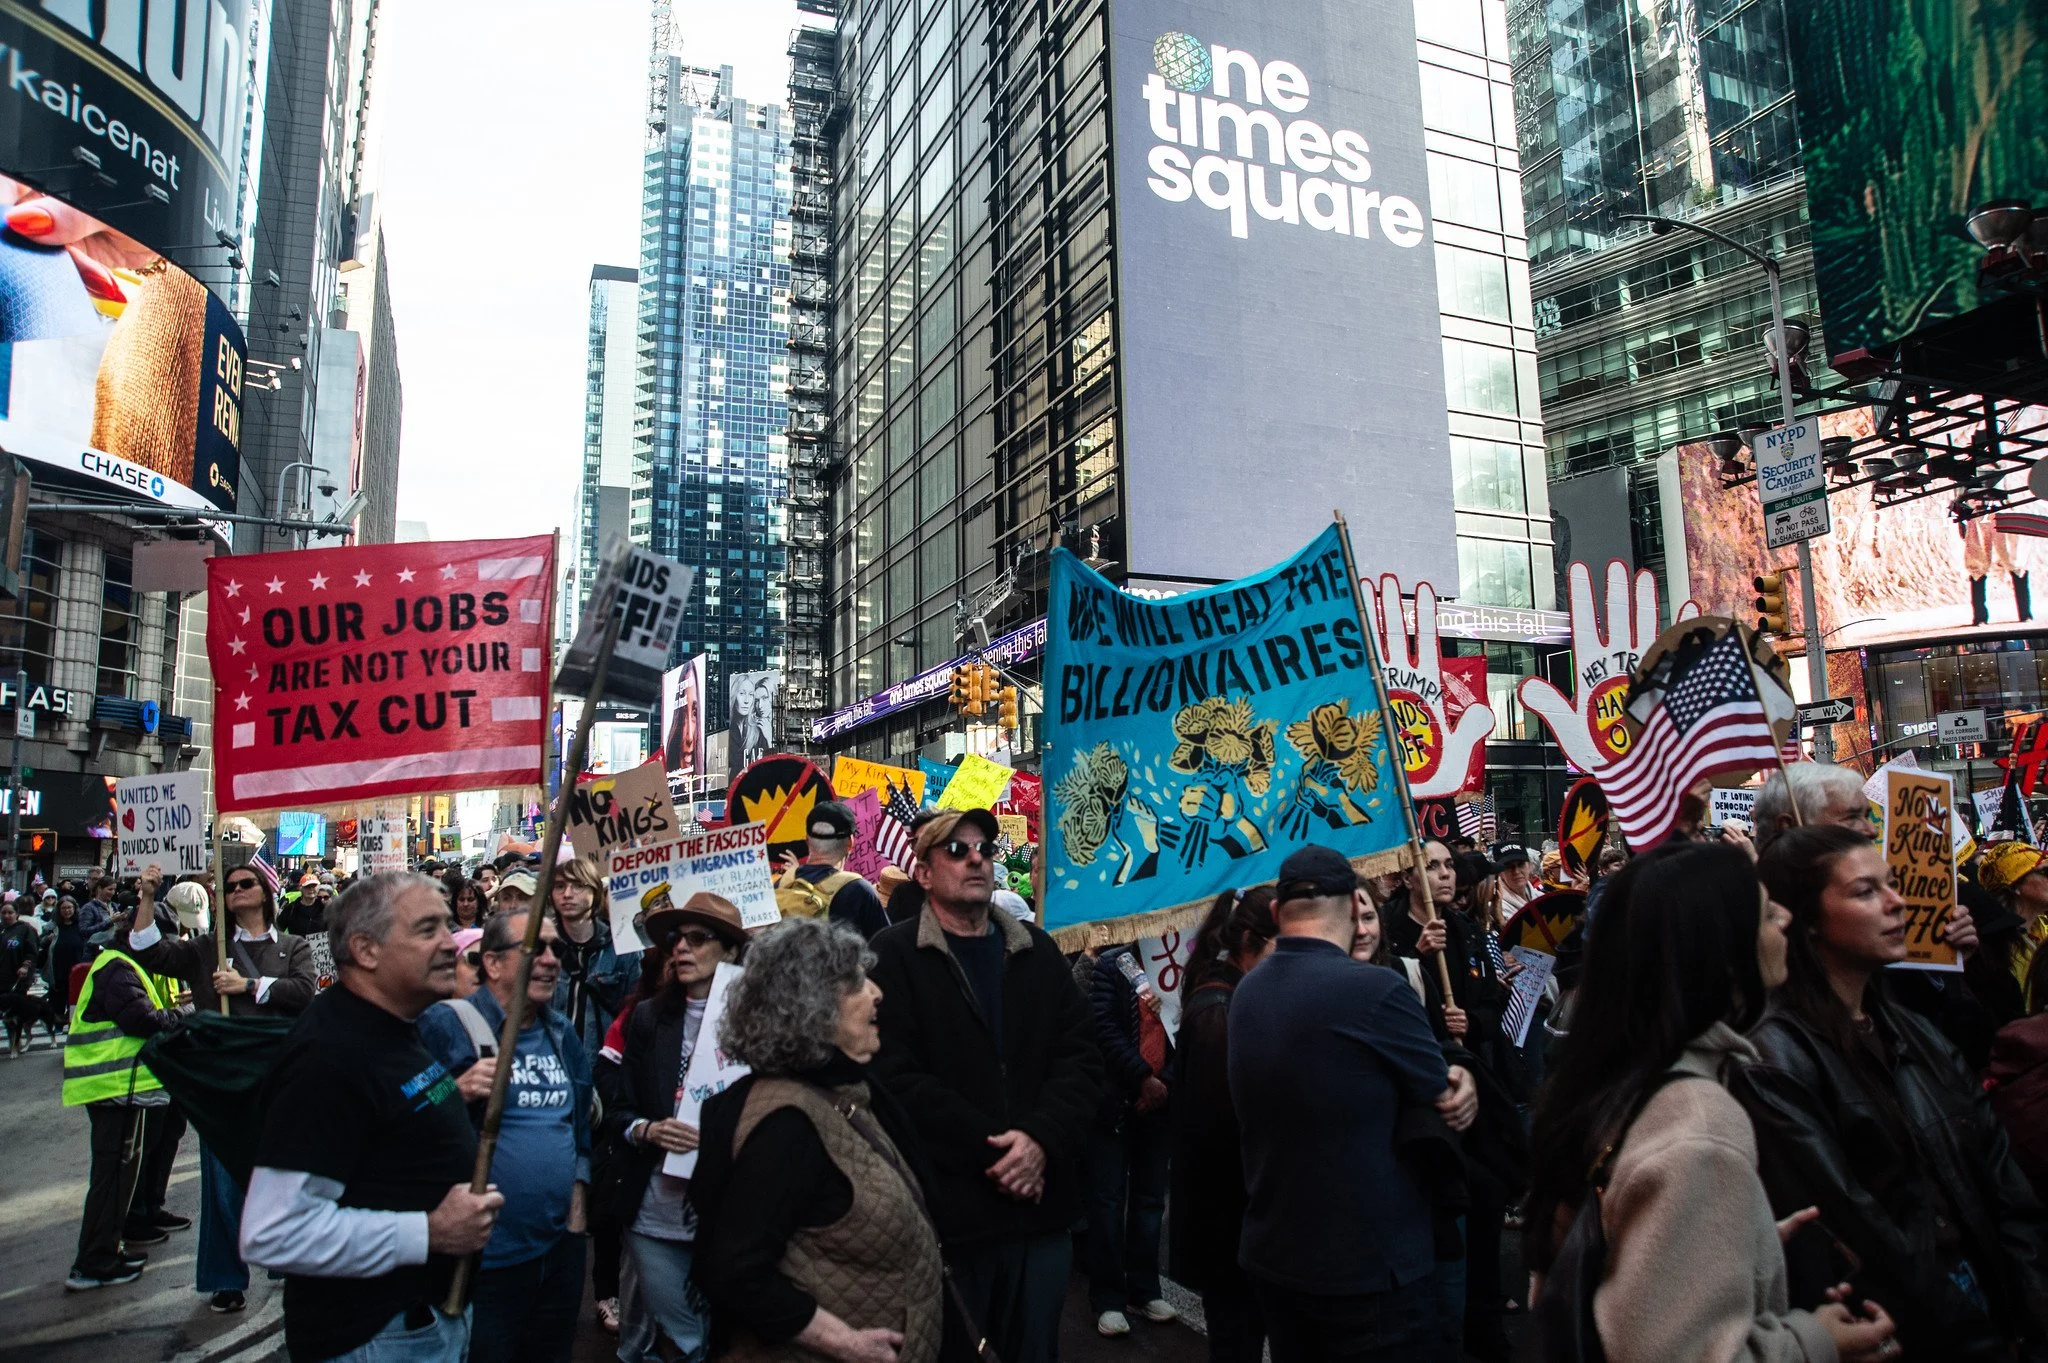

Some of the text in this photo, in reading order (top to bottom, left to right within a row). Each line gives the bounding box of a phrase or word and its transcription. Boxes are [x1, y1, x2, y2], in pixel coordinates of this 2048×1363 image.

[1142, 74, 1371, 182] times
[1147, 145, 1424, 248] square
[204, 188, 233, 237] Liv
[1766, 426, 1806, 448] NYPD
[81, 452, 149, 490] CHASE
[1762, 454, 1816, 479] SECURITY
[1765, 468, 1815, 490] CAMERA
[1788, 483, 1803, 492] AREA
[1775, 493, 1813, 511] BIKE ROUTE
[1770, 523, 1826, 546] IN SHARED LANE
[1775, 516, 1819, 536] DO NOT PASS
[1068, 549, 1348, 648] WE WILL BEAT THE
[263, 592, 509, 648] OUR JOBS
[1472, 609, 1510, 633] this
[1516, 611, 1548, 636] fall
[1014, 632, 1032, 655] this
[268, 642, 511, 693] ARE NOT YOUR
[1060, 618, 1365, 726] BILLIONAIRES
[1582, 651, 1640, 688] HEY TR
[267, 690, 477, 746] TAX CUT
[1392, 700, 1430, 731] NDS
[1800, 704, 1845, 721] NE WAY
[1956, 727, 1980, 735] CORRIDOR
[1958, 734, 1984, 742] ENFORCED
[841, 762, 861, 779] My
[120, 784, 176, 804] UNITED WE
[1720, 791, 1728, 800] IF
[146, 804, 192, 833] STAND
[568, 789, 614, 828] NO
[1714, 801, 1754, 812] DEMOCRAC
[1721, 812, 1729, 820] IS
[361, 819, 374, 834] NO
[595, 800, 669, 848] KINGS
[1417, 803, 1449, 838] YC
[122, 835, 177, 856] DIVIDED WE
[361, 835, 384, 852] KINGS
[612, 824, 766, 873] DEPORT THE FASCISTS
[1890, 822, 1951, 867] Kings
[180, 844, 203, 871] FALL
[588, 850, 599, 862] IN
[610, 849, 756, 891] NOT OUR MIGRANTS
[703, 866, 770, 887] THEY BLAME
[517, 1090, 569, 1108] 86/47
